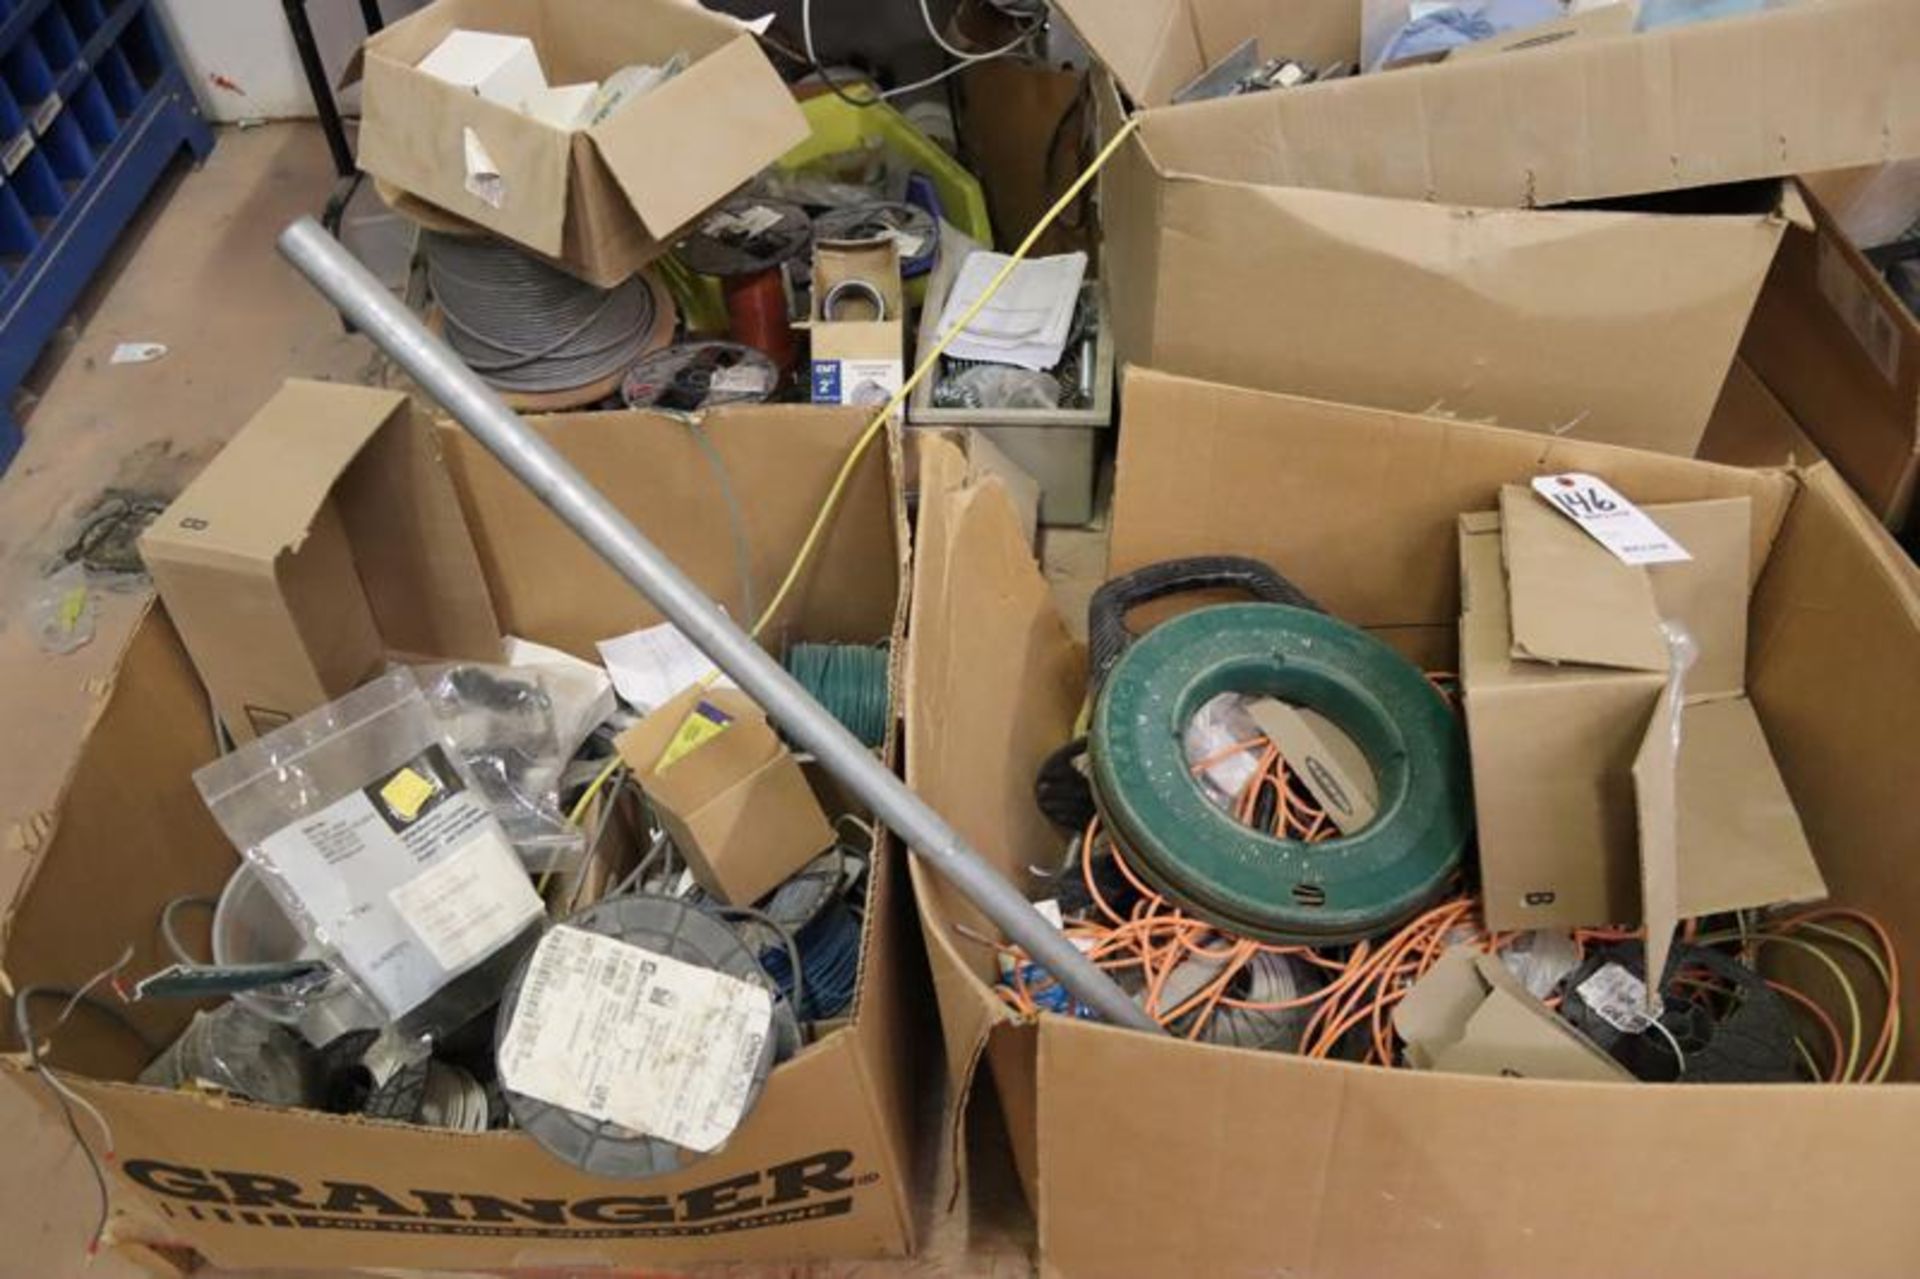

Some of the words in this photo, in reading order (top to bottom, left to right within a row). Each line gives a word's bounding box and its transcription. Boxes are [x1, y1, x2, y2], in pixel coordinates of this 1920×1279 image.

[1552, 487, 1618, 518] 146
[1525, 892, 1556, 906] B
[122, 1150, 855, 1225] GRAINGER
